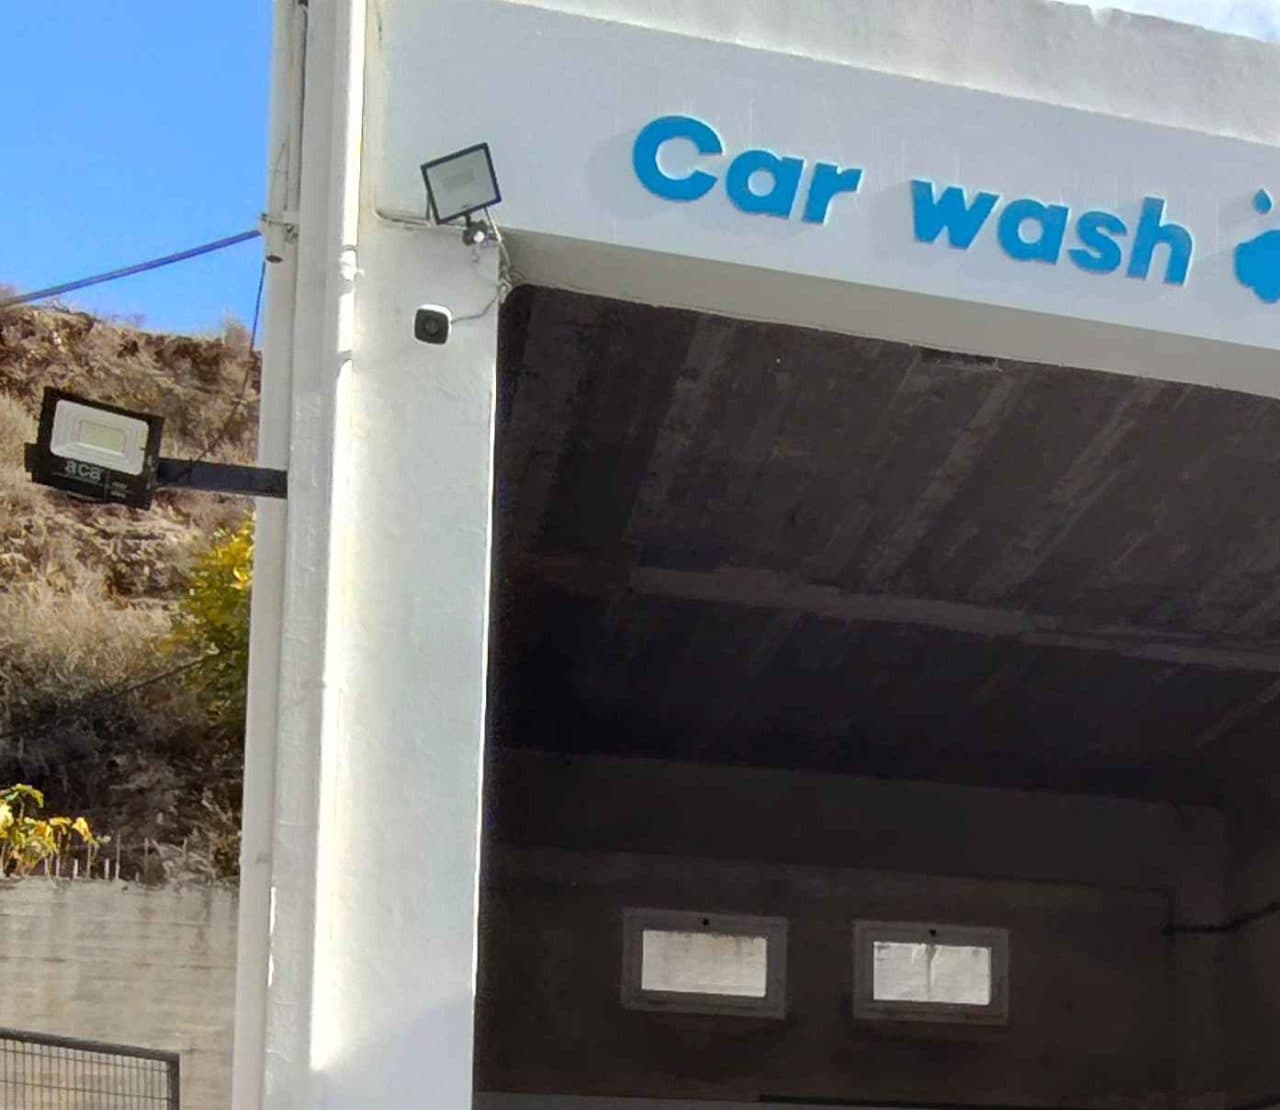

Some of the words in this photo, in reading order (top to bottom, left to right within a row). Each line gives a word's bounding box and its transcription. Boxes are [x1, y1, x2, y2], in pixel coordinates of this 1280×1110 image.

[632, 115, 863, 225] Car
[911, 179, 1195, 286] wash
[64, 460, 102, 481] aca
